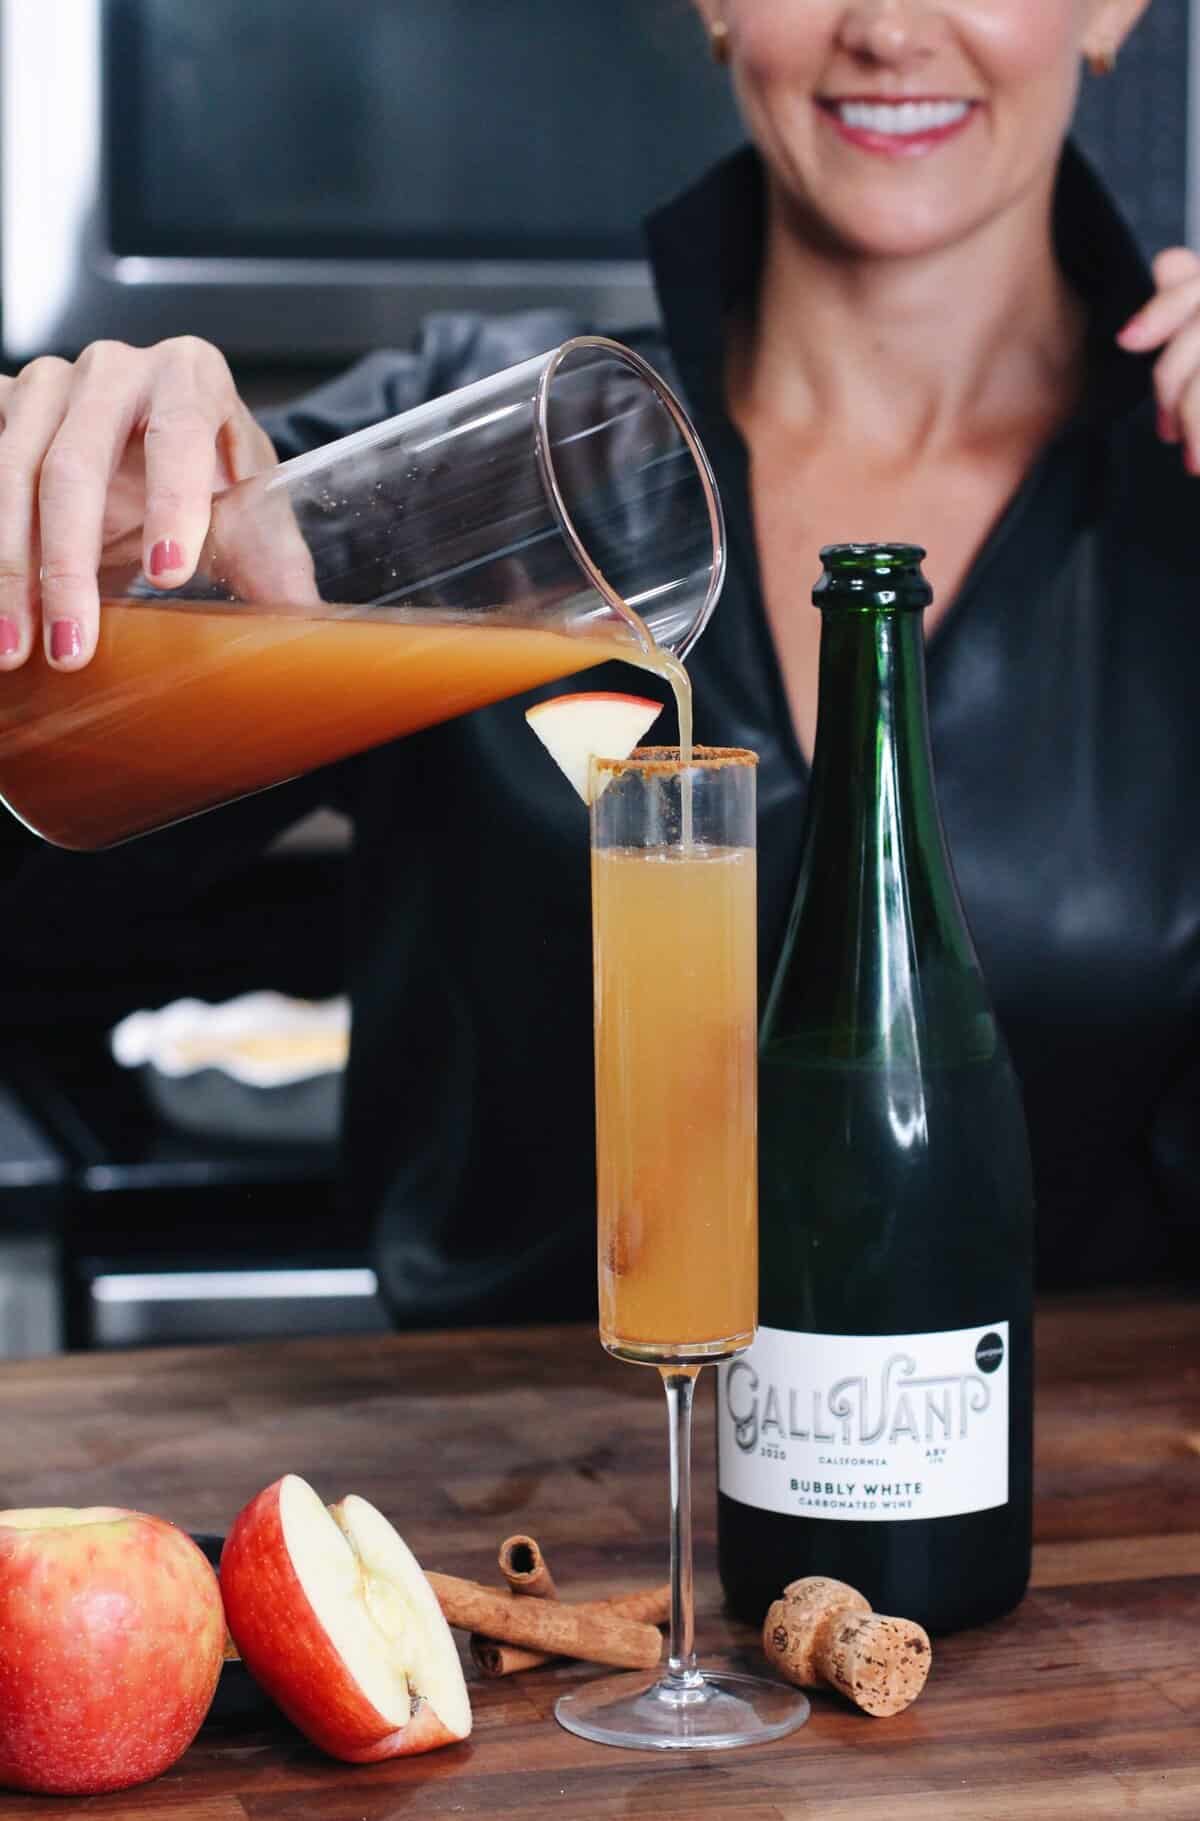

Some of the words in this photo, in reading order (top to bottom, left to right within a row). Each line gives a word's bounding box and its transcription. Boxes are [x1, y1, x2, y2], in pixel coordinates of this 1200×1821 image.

[818, 1456, 888, 1466] CALIFORNIA
[790, 1478, 856, 1496] BUBBLY
[863, 1482, 922, 1496] WHITE
[798, 1497, 877, 1509] CARBONATED
[882, 1499, 913, 1509] WINE
